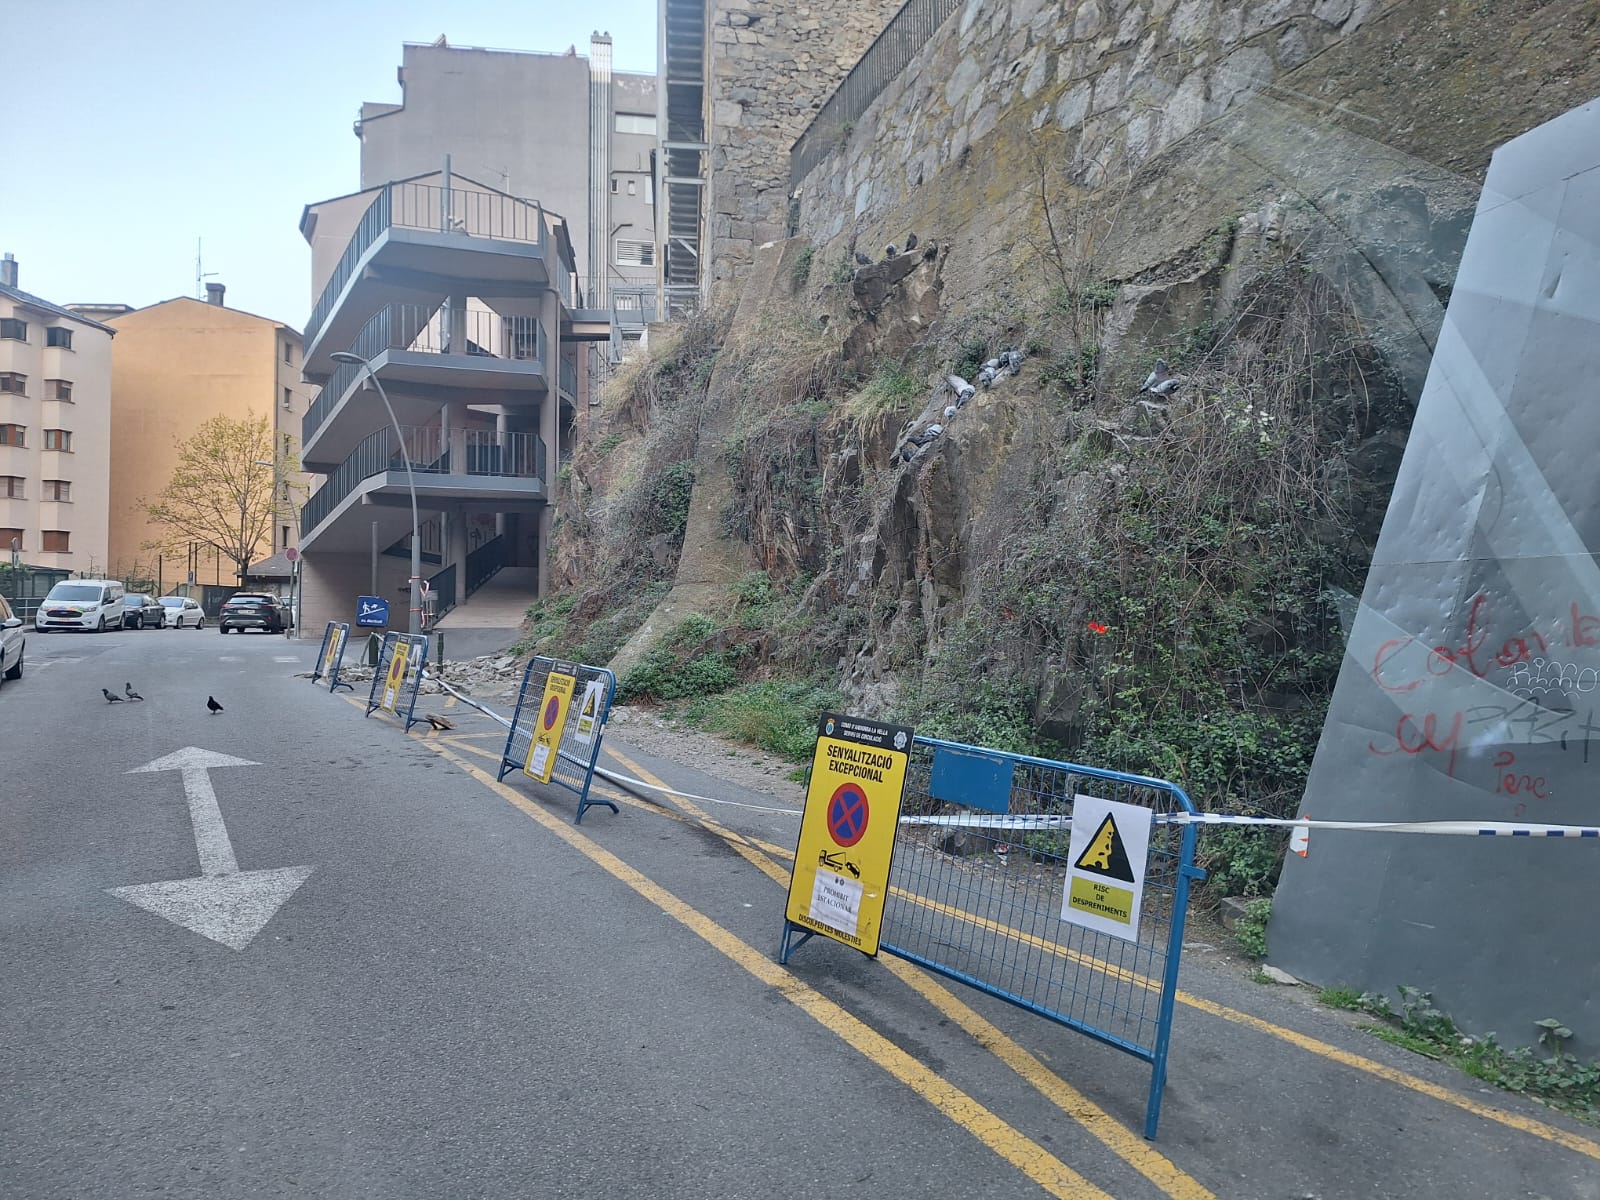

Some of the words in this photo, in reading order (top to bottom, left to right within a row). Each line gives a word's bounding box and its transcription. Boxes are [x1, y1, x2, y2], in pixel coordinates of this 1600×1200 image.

[827, 744, 893, 770] SENYALITZACIÓ
[828, 760, 884, 783] EXCEPCIONAL
[823, 886, 849, 902] PROHIBIT
[1093, 884, 1110, 894] RISC
[1072, 896, 1127, 918] DESPRENIMENTS
[824, 925, 834, 934] LES
